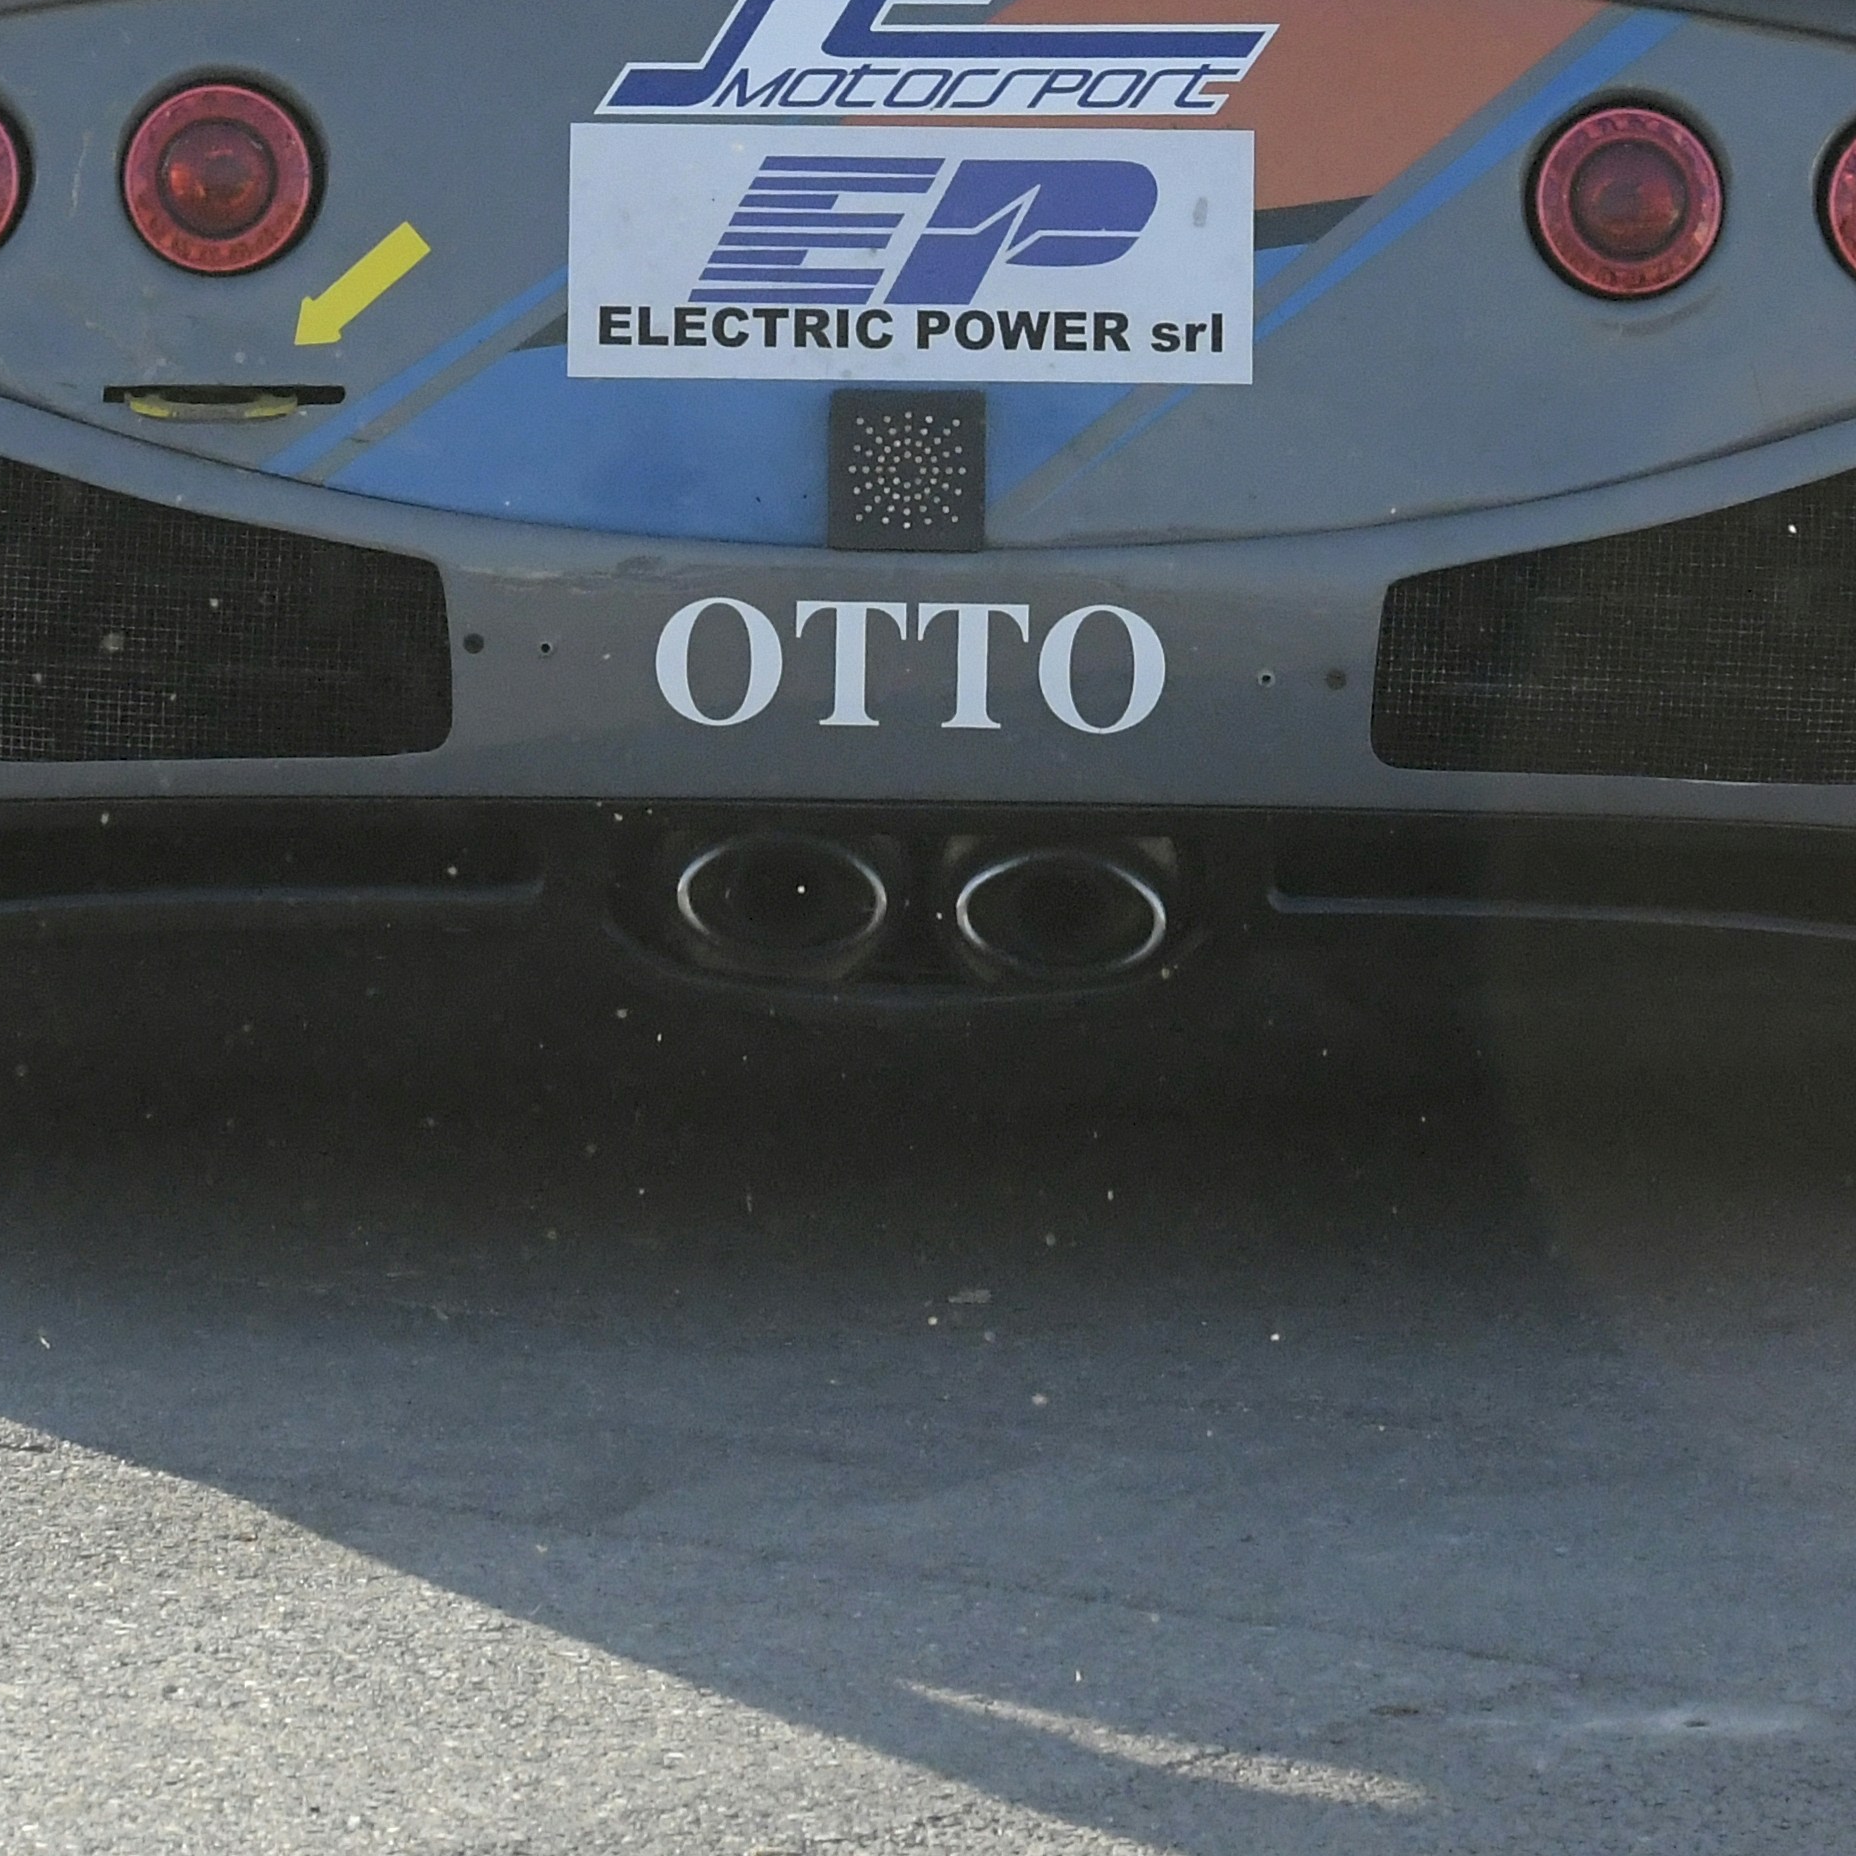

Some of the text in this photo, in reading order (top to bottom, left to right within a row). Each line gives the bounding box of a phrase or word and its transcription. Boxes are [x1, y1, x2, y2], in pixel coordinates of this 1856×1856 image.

[687, 156, 1159, 305] EP
[598, 305, 1224, 353] ELECTRIC POWER srl
[655, 597, 1167, 734] OTTO
